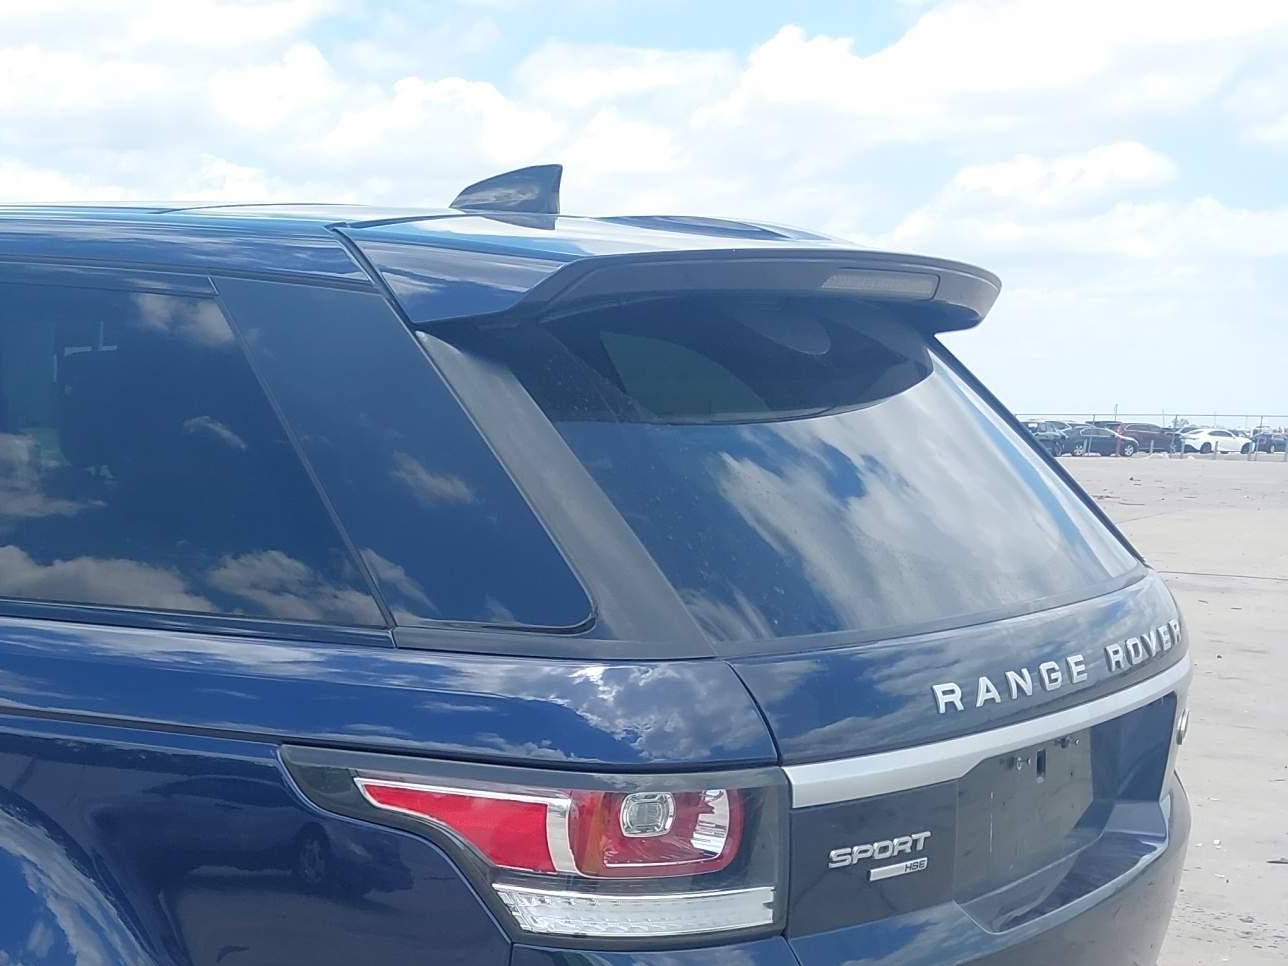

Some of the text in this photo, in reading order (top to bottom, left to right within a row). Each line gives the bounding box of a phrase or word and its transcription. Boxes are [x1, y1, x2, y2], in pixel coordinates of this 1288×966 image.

[932, 618, 1182, 714] RANGE ROVER
[828, 831, 931, 869] SPORT
[904, 859, 927, 873] HSE
